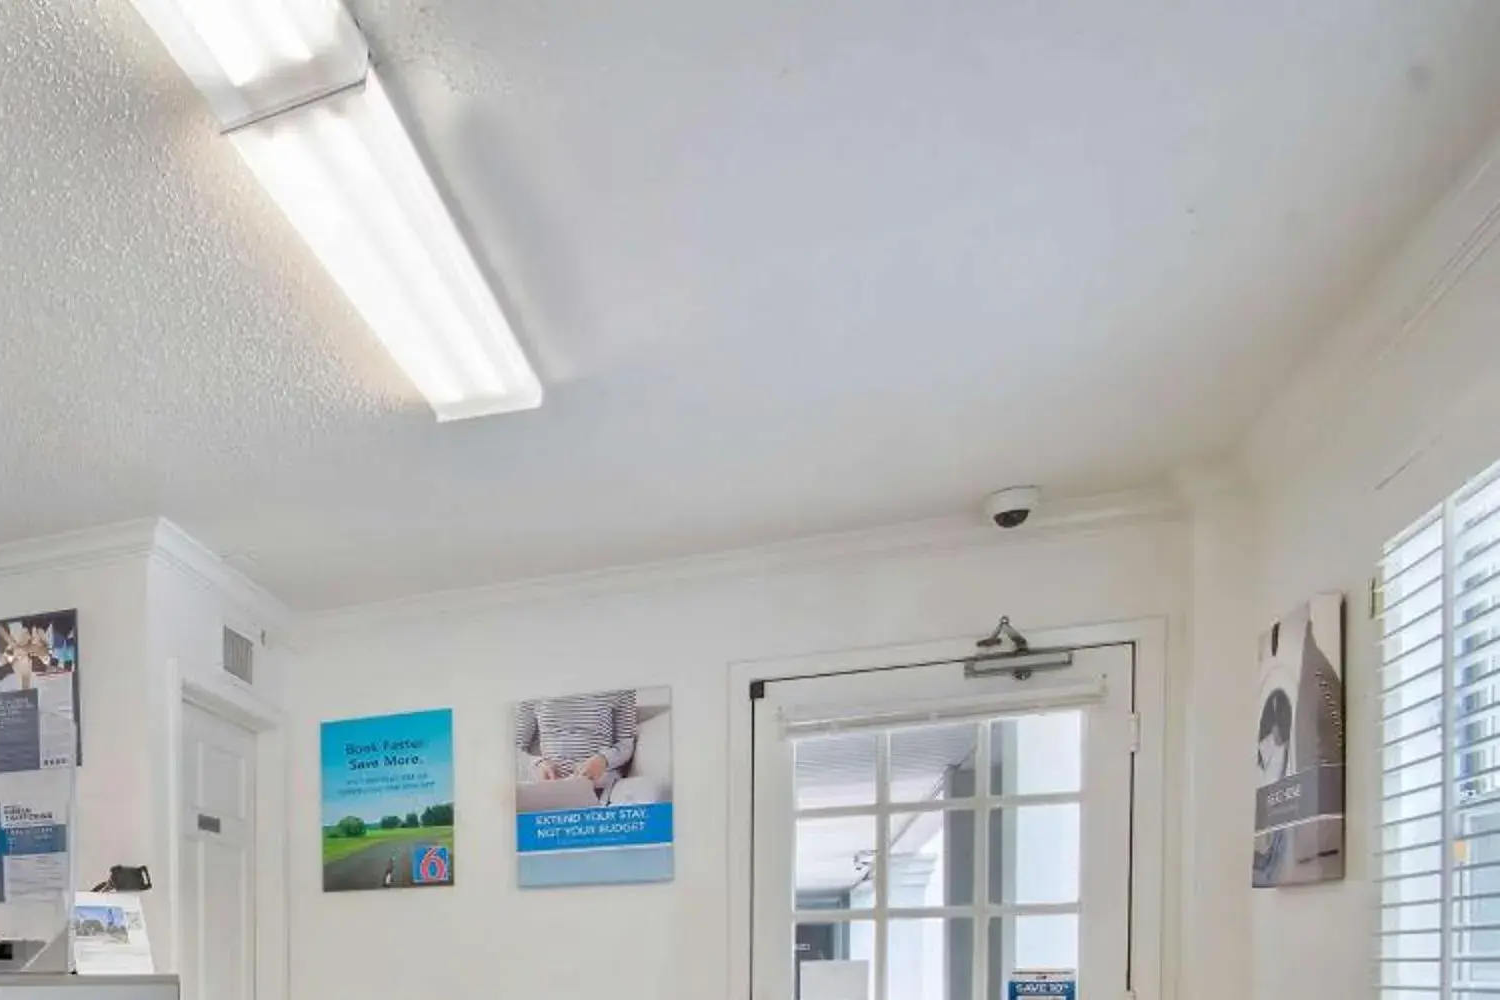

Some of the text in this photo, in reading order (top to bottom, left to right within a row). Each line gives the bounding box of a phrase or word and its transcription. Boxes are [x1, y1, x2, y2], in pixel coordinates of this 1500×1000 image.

[348, 758, 379, 770] Save
[535, 813, 580, 825] EXTEND
[584, 810, 617, 821] YOUR
[537, 827, 561, 838] NOT
[565, 825, 595, 836] YOUR
[420, 848, 446, 881] 6
